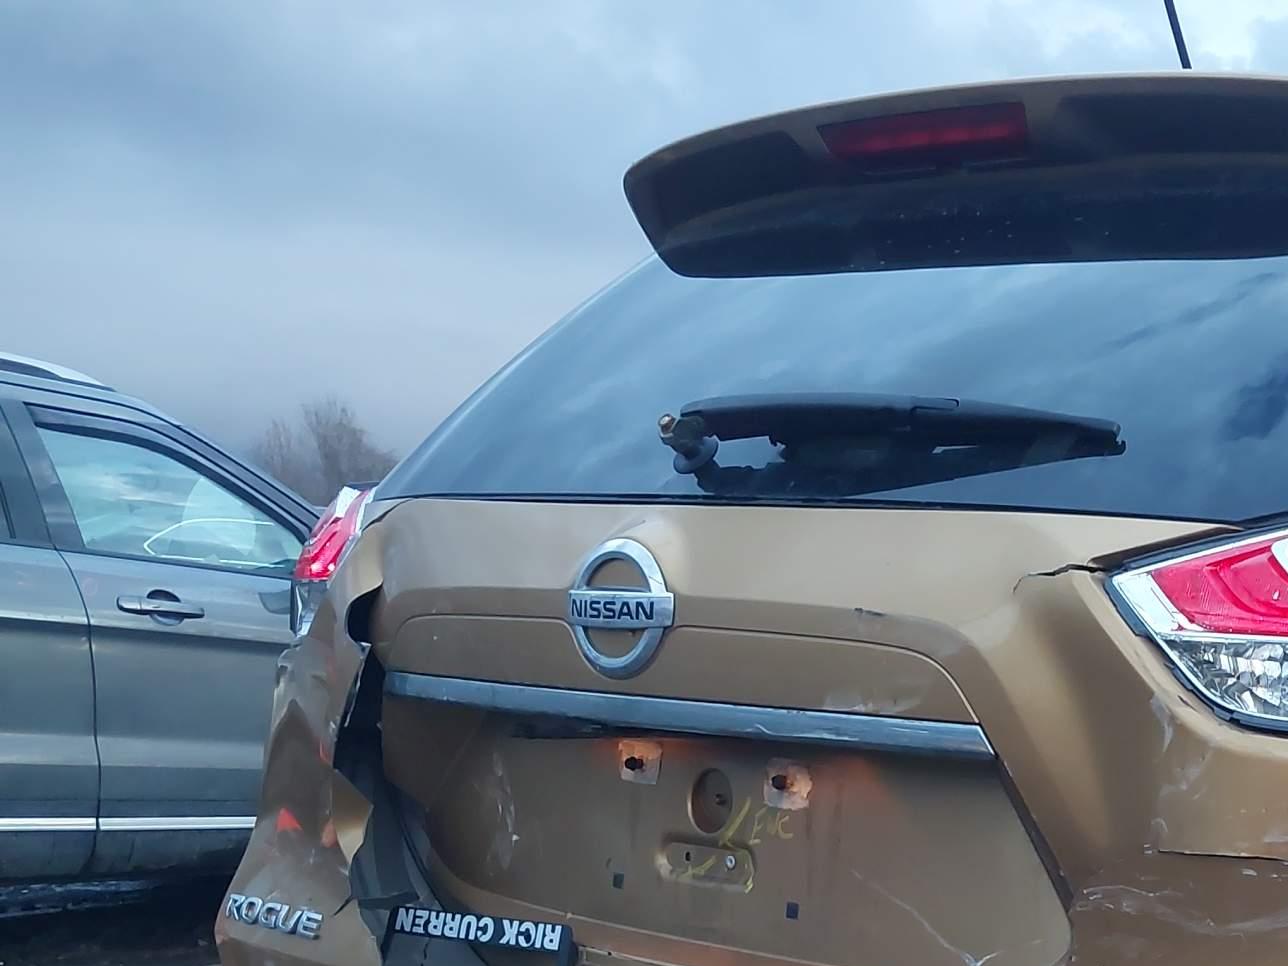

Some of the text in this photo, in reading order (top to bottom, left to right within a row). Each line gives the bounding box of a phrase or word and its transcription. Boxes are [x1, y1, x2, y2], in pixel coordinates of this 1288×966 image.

[571, 598, 655, 621] NISSAN
[226, 893, 324, 941] ROGUE
[394, 907, 563, 951] RICK CURREN
